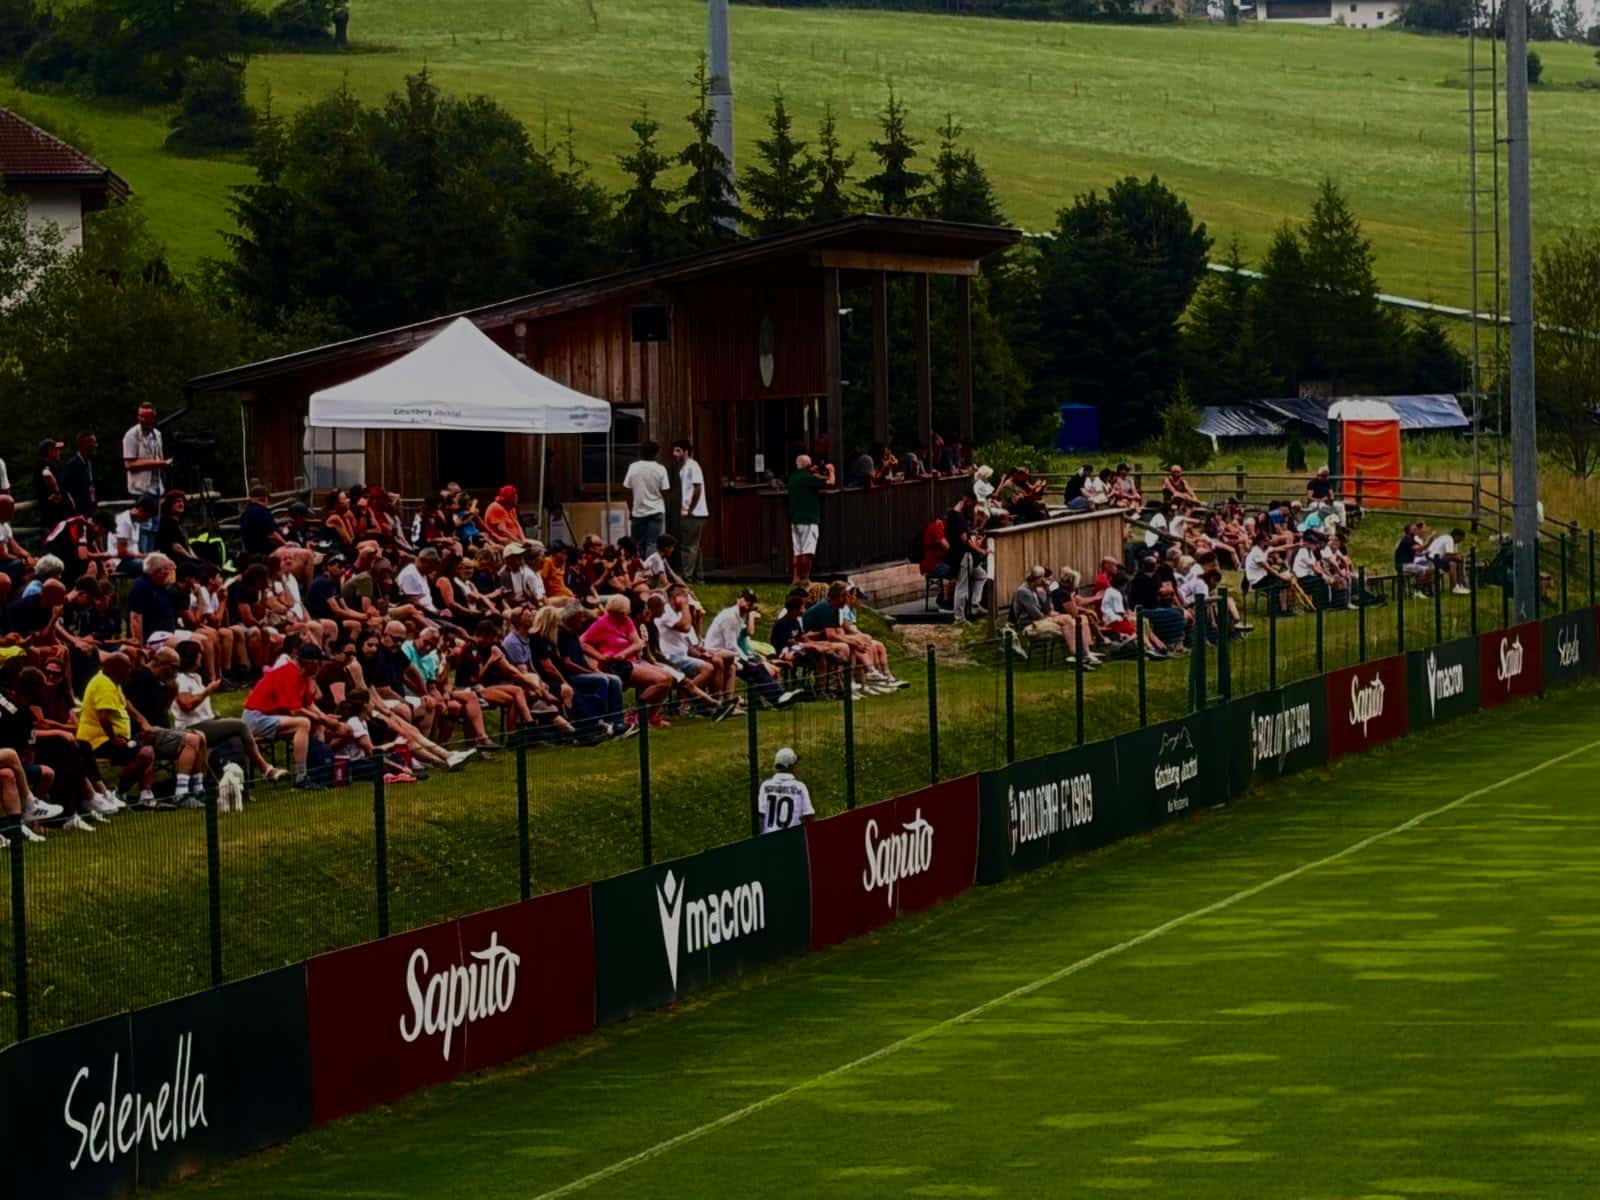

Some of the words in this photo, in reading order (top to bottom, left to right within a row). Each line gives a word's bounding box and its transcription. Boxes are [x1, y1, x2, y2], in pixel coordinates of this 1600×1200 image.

[1349, 672, 1384, 738] Saputo
[1436, 664, 1463, 698] macron
[767, 794, 794, 828] 10
[1018, 782, 1060, 844] BOLOGNA
[1060, 779, 1072, 832] FC
[1070, 772, 1094, 828] 1909
[863, 808, 933, 907] Saputo
[686, 881, 764, 952] macron
[400, 931, 520, 1061] Saputo
[63, 1031, 208, 1170] Selenella
